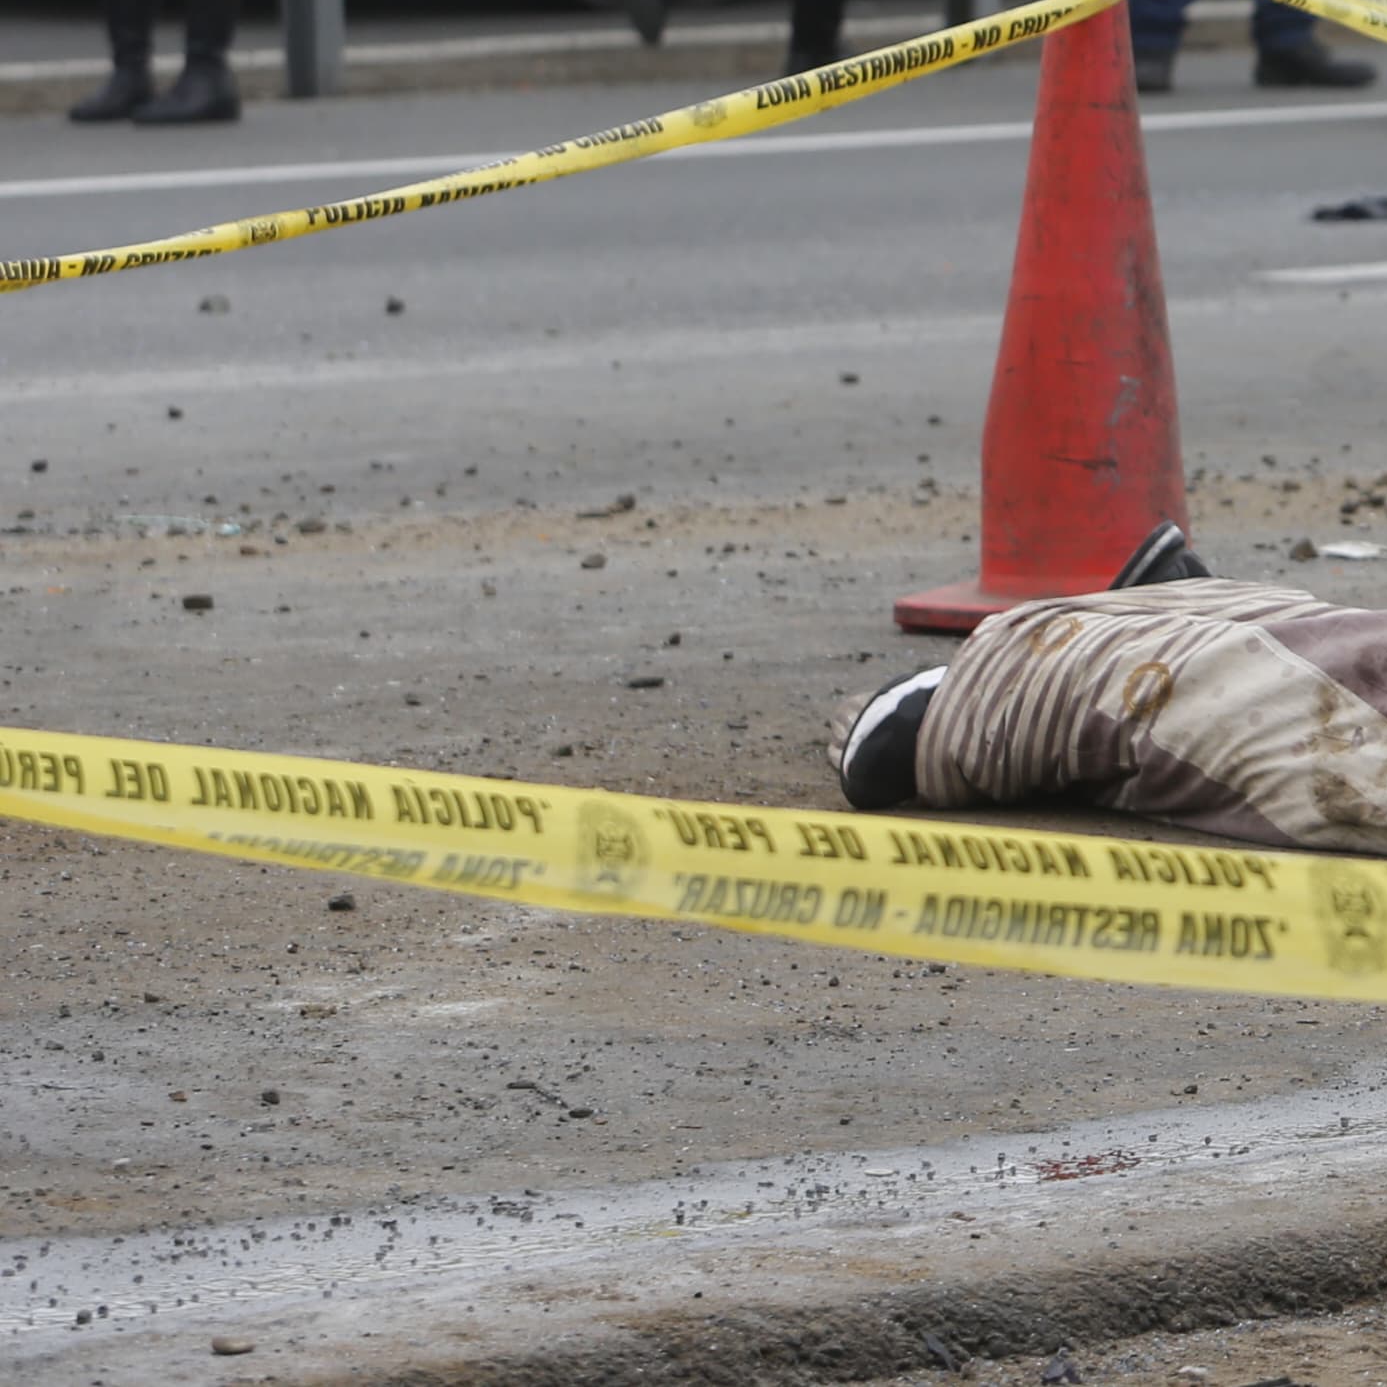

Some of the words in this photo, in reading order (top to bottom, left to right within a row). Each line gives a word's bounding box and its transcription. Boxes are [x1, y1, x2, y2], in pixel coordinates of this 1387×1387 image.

[819, 38, 955, 96] RESTRINGIDA
[970, 23, 1002, 53] NO
[80, 255, 117, 277] NO
